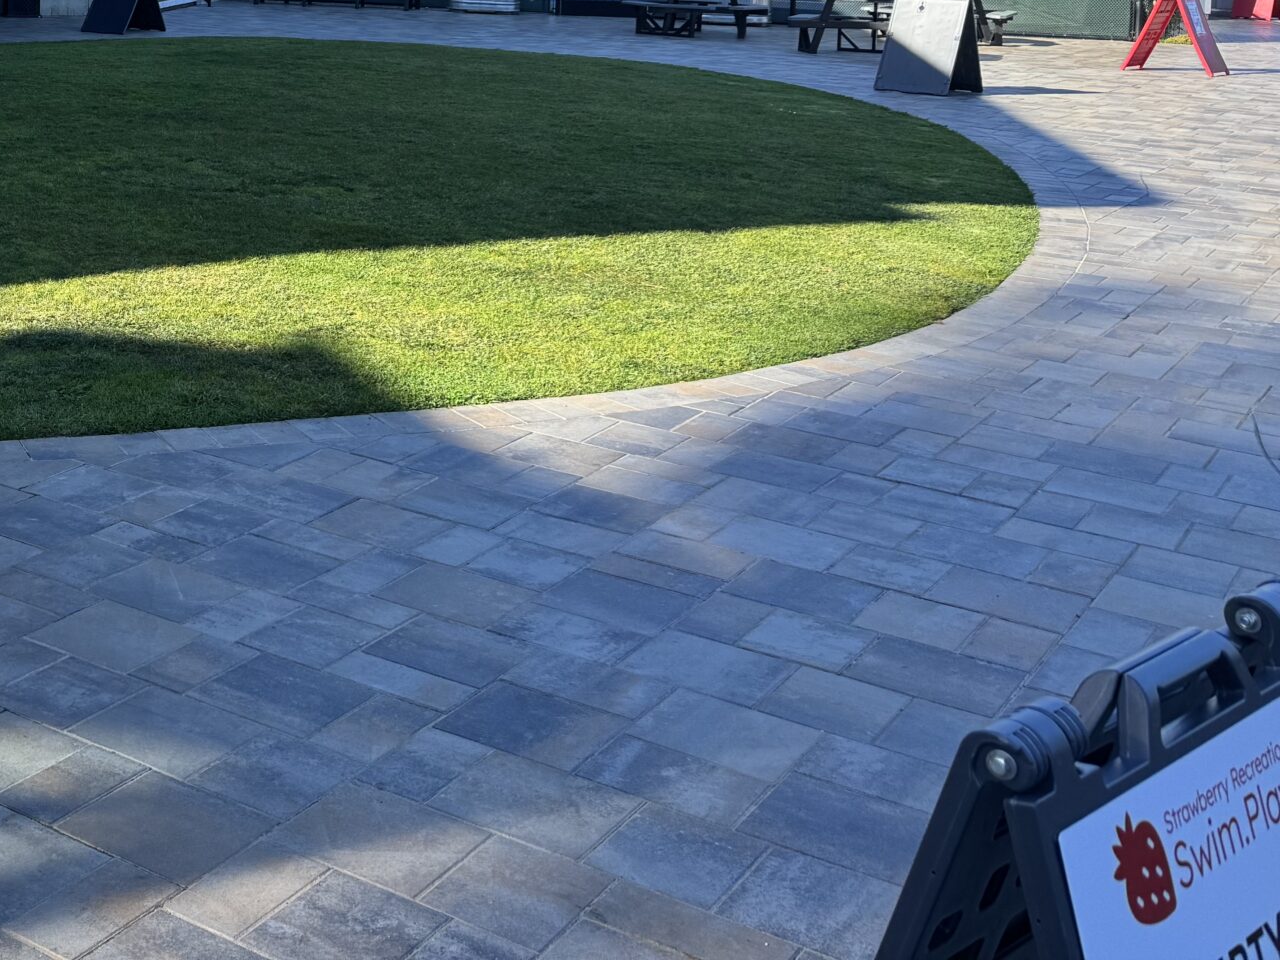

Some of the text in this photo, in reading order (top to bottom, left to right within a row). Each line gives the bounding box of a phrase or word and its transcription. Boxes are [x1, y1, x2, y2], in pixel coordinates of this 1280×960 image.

[1163, 741, 1280, 835] Strawberry Recreatio
[1174, 784, 1280, 889] Swim.Pla
